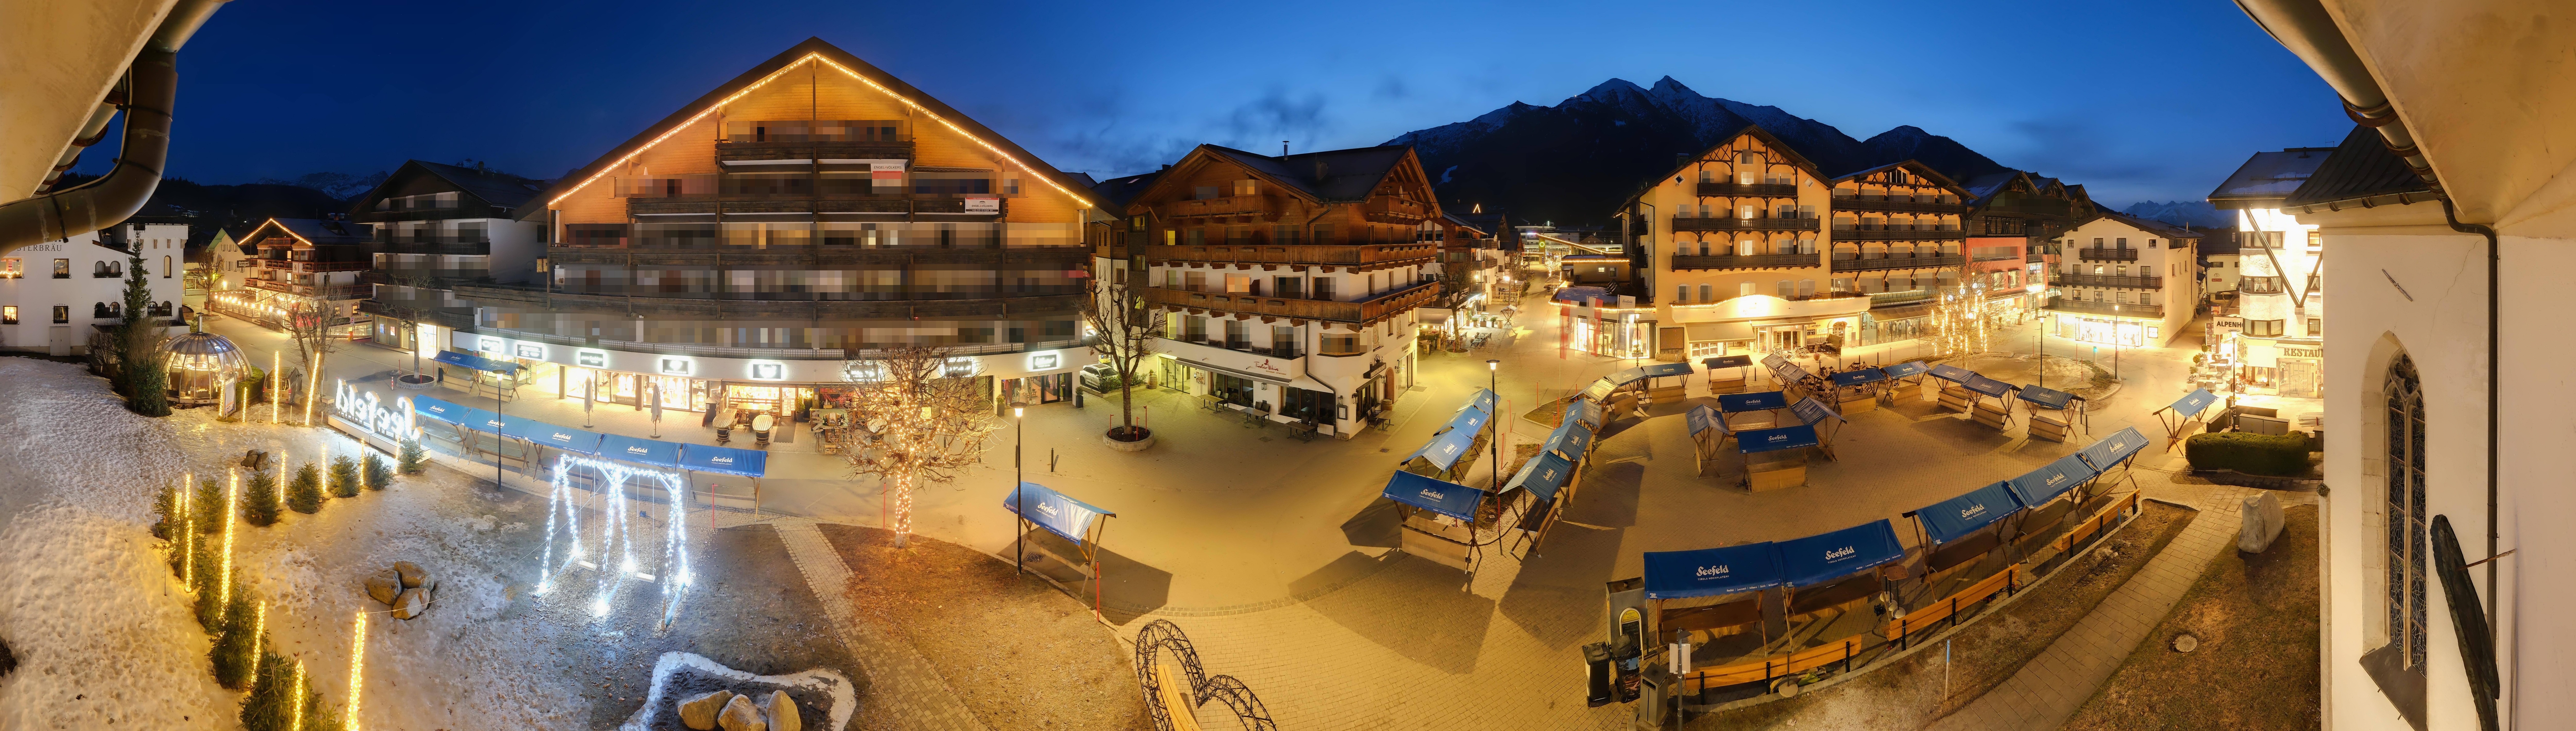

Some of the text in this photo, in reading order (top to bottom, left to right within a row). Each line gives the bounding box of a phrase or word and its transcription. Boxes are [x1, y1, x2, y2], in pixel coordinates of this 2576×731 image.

[1402, 343, 1410, 351] SAILER
[1371, 364, 1386, 377] RESTAURANT
[1444, 443, 1455, 453] Seefeld
[2109, 442, 2124, 452] Seefeld
[1543, 468, 1554, 481] Seefeld
[2046, 473, 2064, 486] Seefeld
[1420, 488, 1444, 499] Seefeld
[1038, 502, 1059, 516] Seefeld
[1962, 504, 1985, 518] Seefeld
[1825, 545, 1855, 560] Seefeld
[1696, 565, 1729, 577] Seefeld
